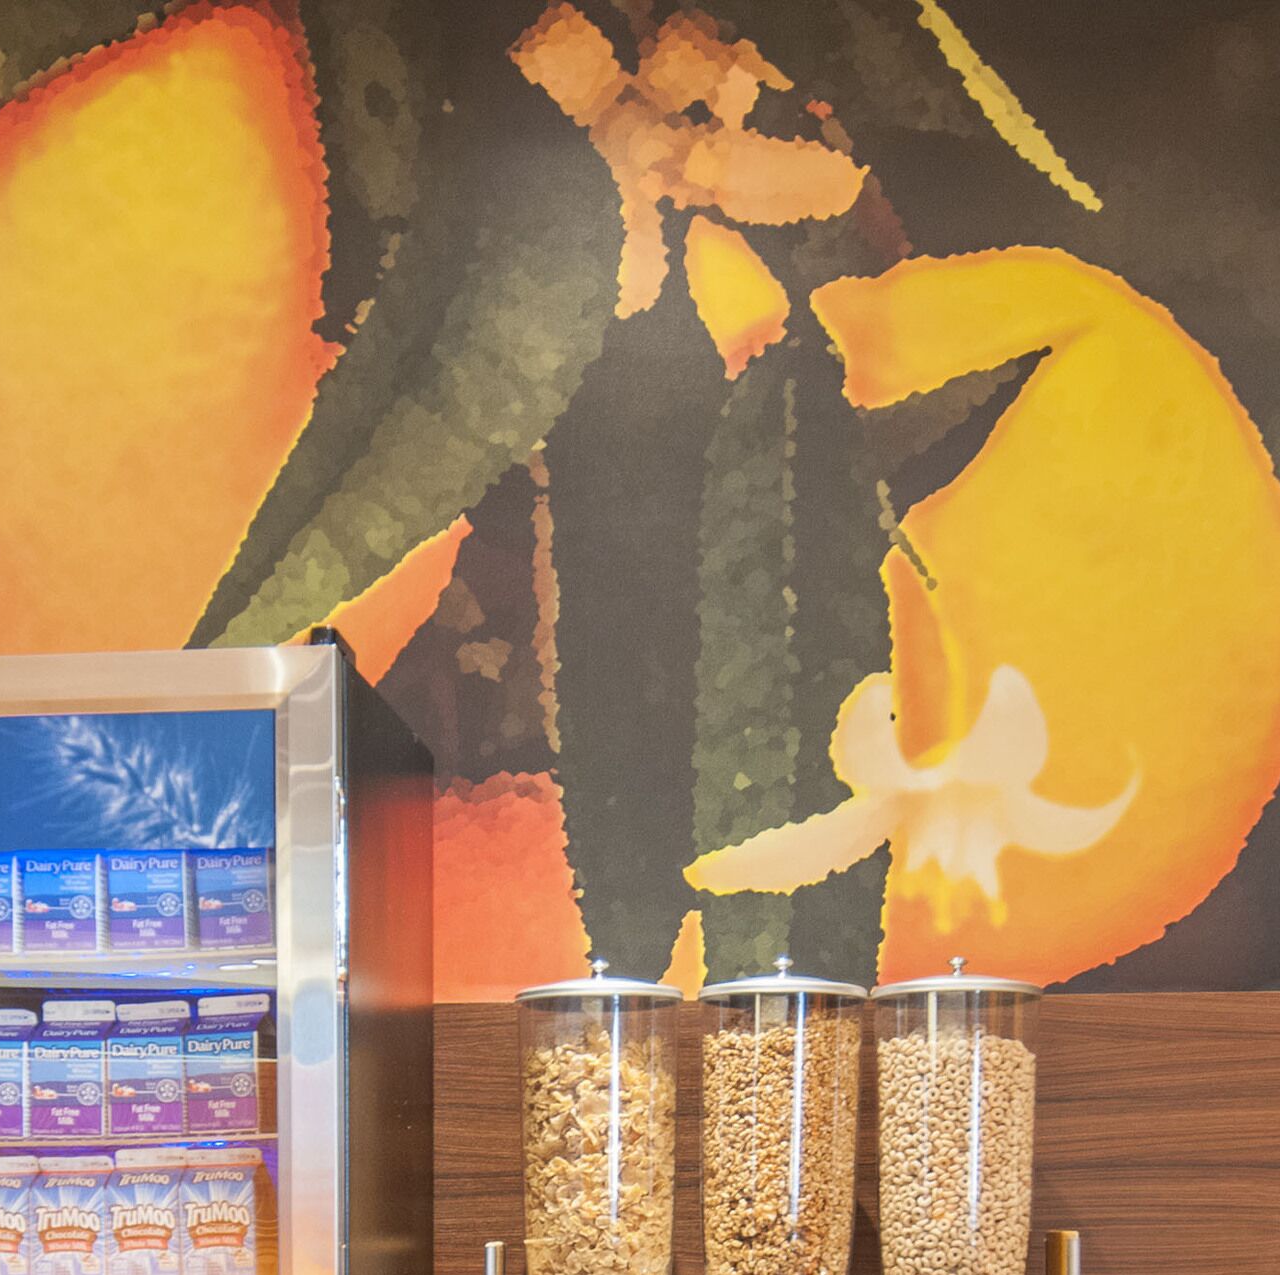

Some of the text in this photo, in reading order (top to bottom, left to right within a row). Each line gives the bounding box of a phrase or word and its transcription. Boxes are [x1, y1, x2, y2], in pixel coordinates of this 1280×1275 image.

[45, 1177, 96, 1188] TruMoo
[120, 1173, 169, 1185] TruMoo
[194, 1171, 243, 1183] TruMoo
[36, 1207, 100, 1232] TruMoo
[111, 1205, 175, 1230] TruMoo
[184, 1202, 250, 1226] TruMoo
